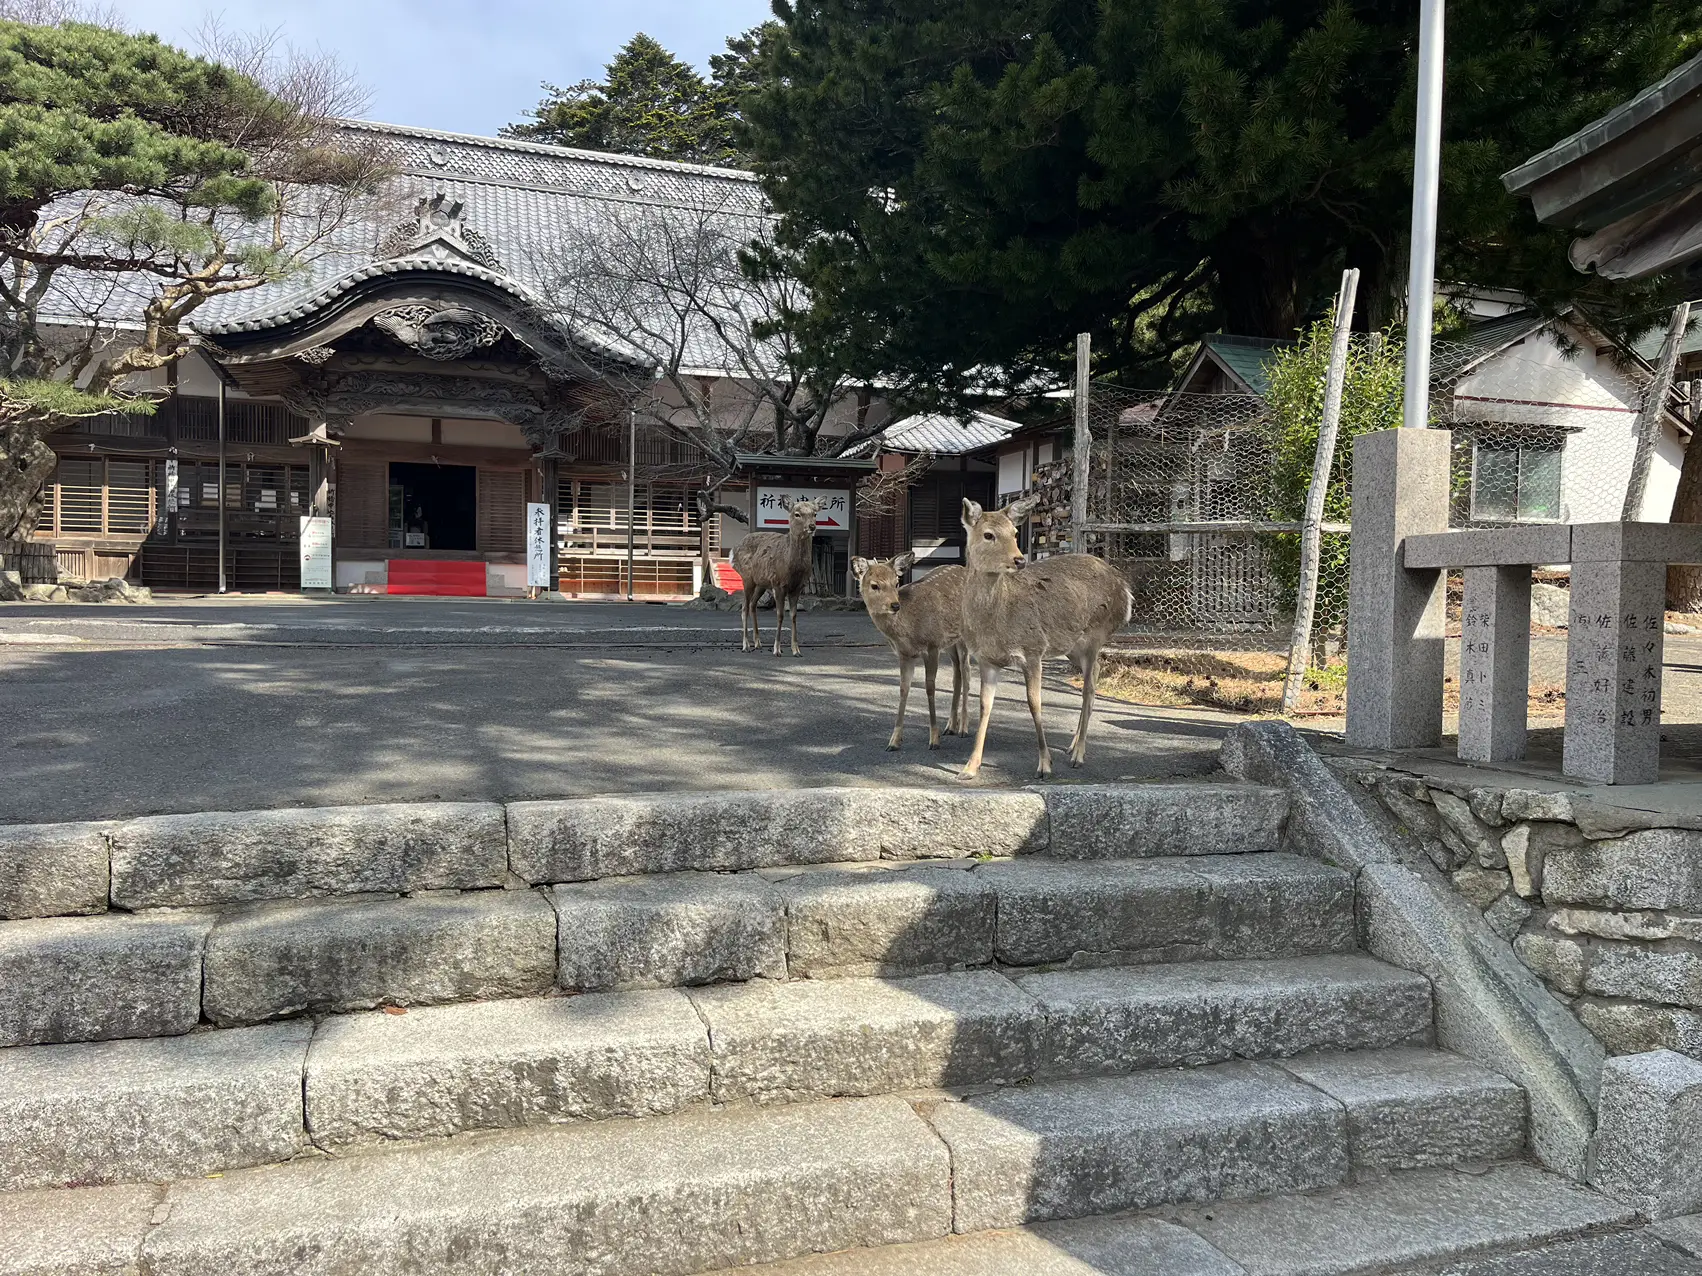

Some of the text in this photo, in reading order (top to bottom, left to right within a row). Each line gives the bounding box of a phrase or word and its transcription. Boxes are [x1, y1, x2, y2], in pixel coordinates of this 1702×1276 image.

[760, 493, 846, 512] 祈申所
[1621, 614, 1638, 726] 佐藤建設
[1641, 615, 1658, 726] 佐々木初男
